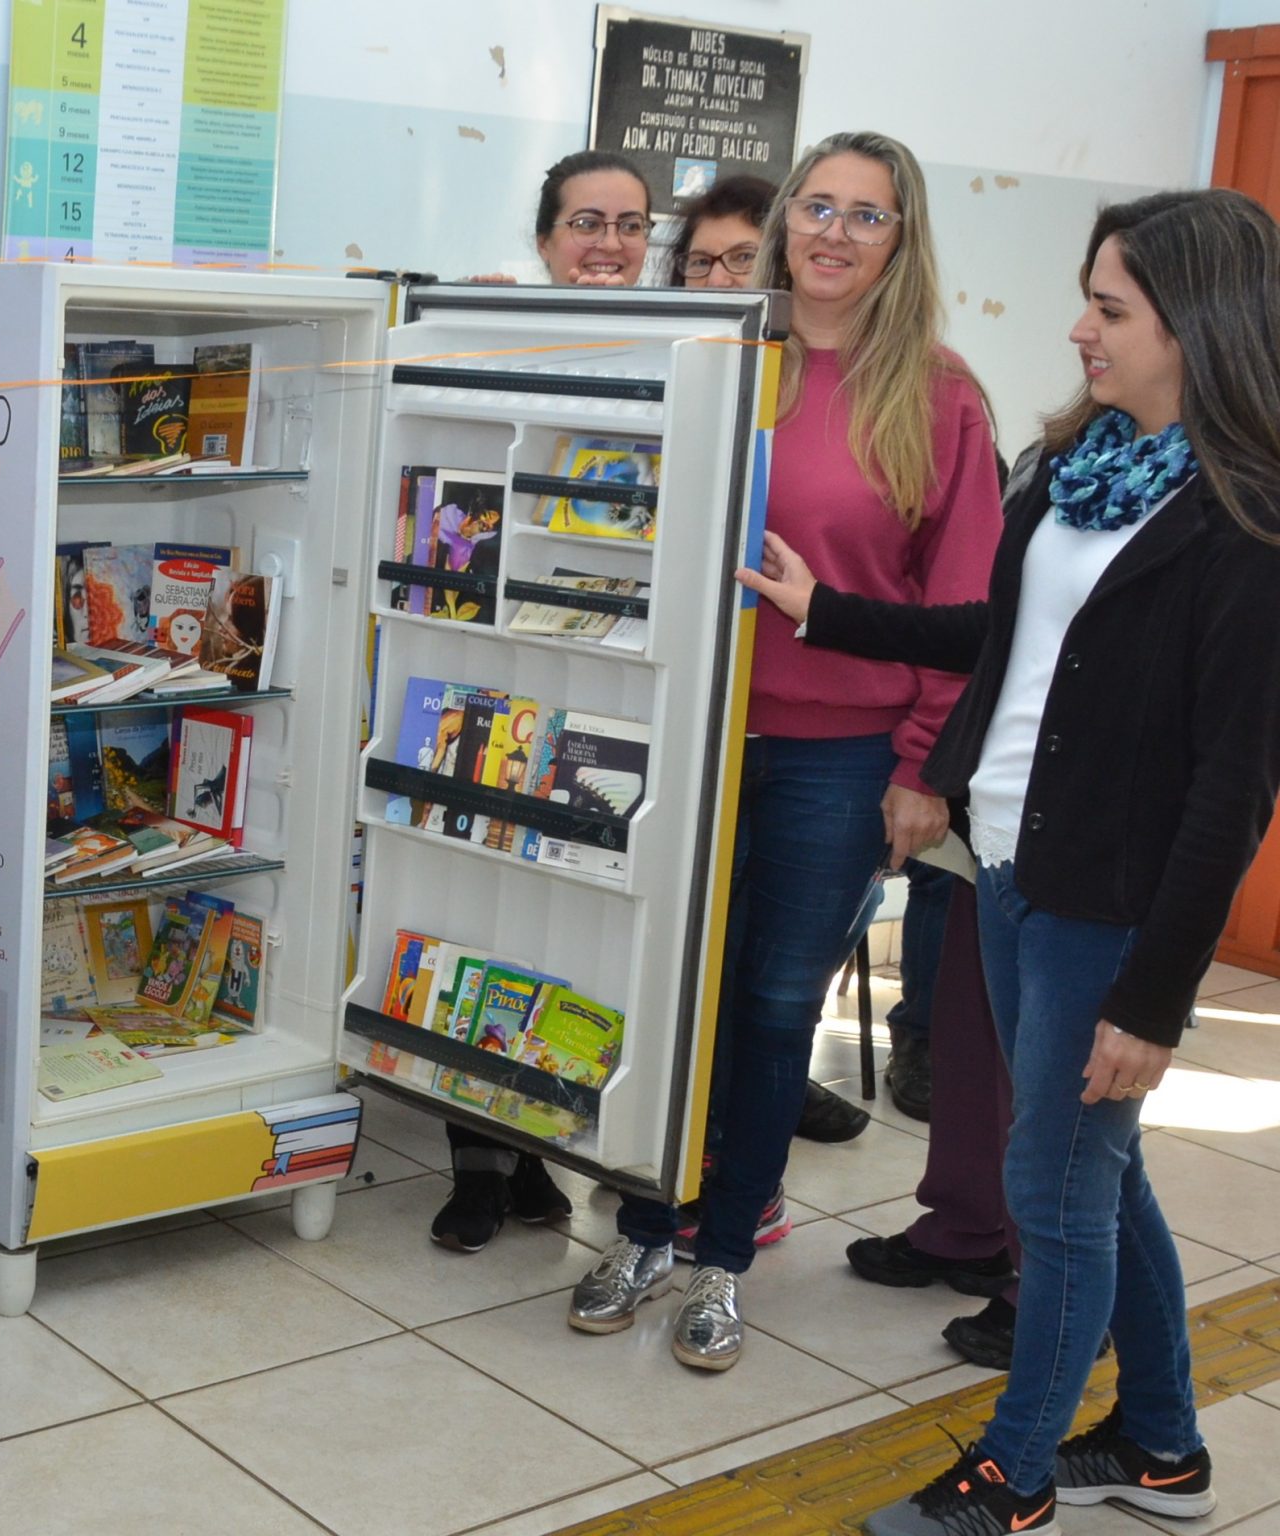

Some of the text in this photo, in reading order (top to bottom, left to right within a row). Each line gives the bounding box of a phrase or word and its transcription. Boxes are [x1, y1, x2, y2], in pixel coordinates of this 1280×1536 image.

[71, 22, 87, 49] 4
[690, 30, 726, 54] NUBES
[677, 53, 688, 66] DE
[693, 54, 709, 68] BEM
[712, 57, 736, 71] ESTAR
[739, 60, 766, 76] SOCIAL
[62, 75, 68, 87] 5
[642, 65, 765, 100] DR. THOMAZ NOVELINO
[60, 102, 67, 113] 6
[664, 96, 739, 114] JARDIM PLANALTO
[59, 127, 65, 138] 9
[689, 116, 695, 130] E
[699, 118, 744, 135] INAUGURADO
[748, 124, 757, 135] NA
[623, 126, 769, 163] ADM. ARY PEDRO BALIEIRO
[62, 152, 84, 173] 12
[61, 201, 82, 221] 15
[165, 584, 208, 598] SEBASTIAN
